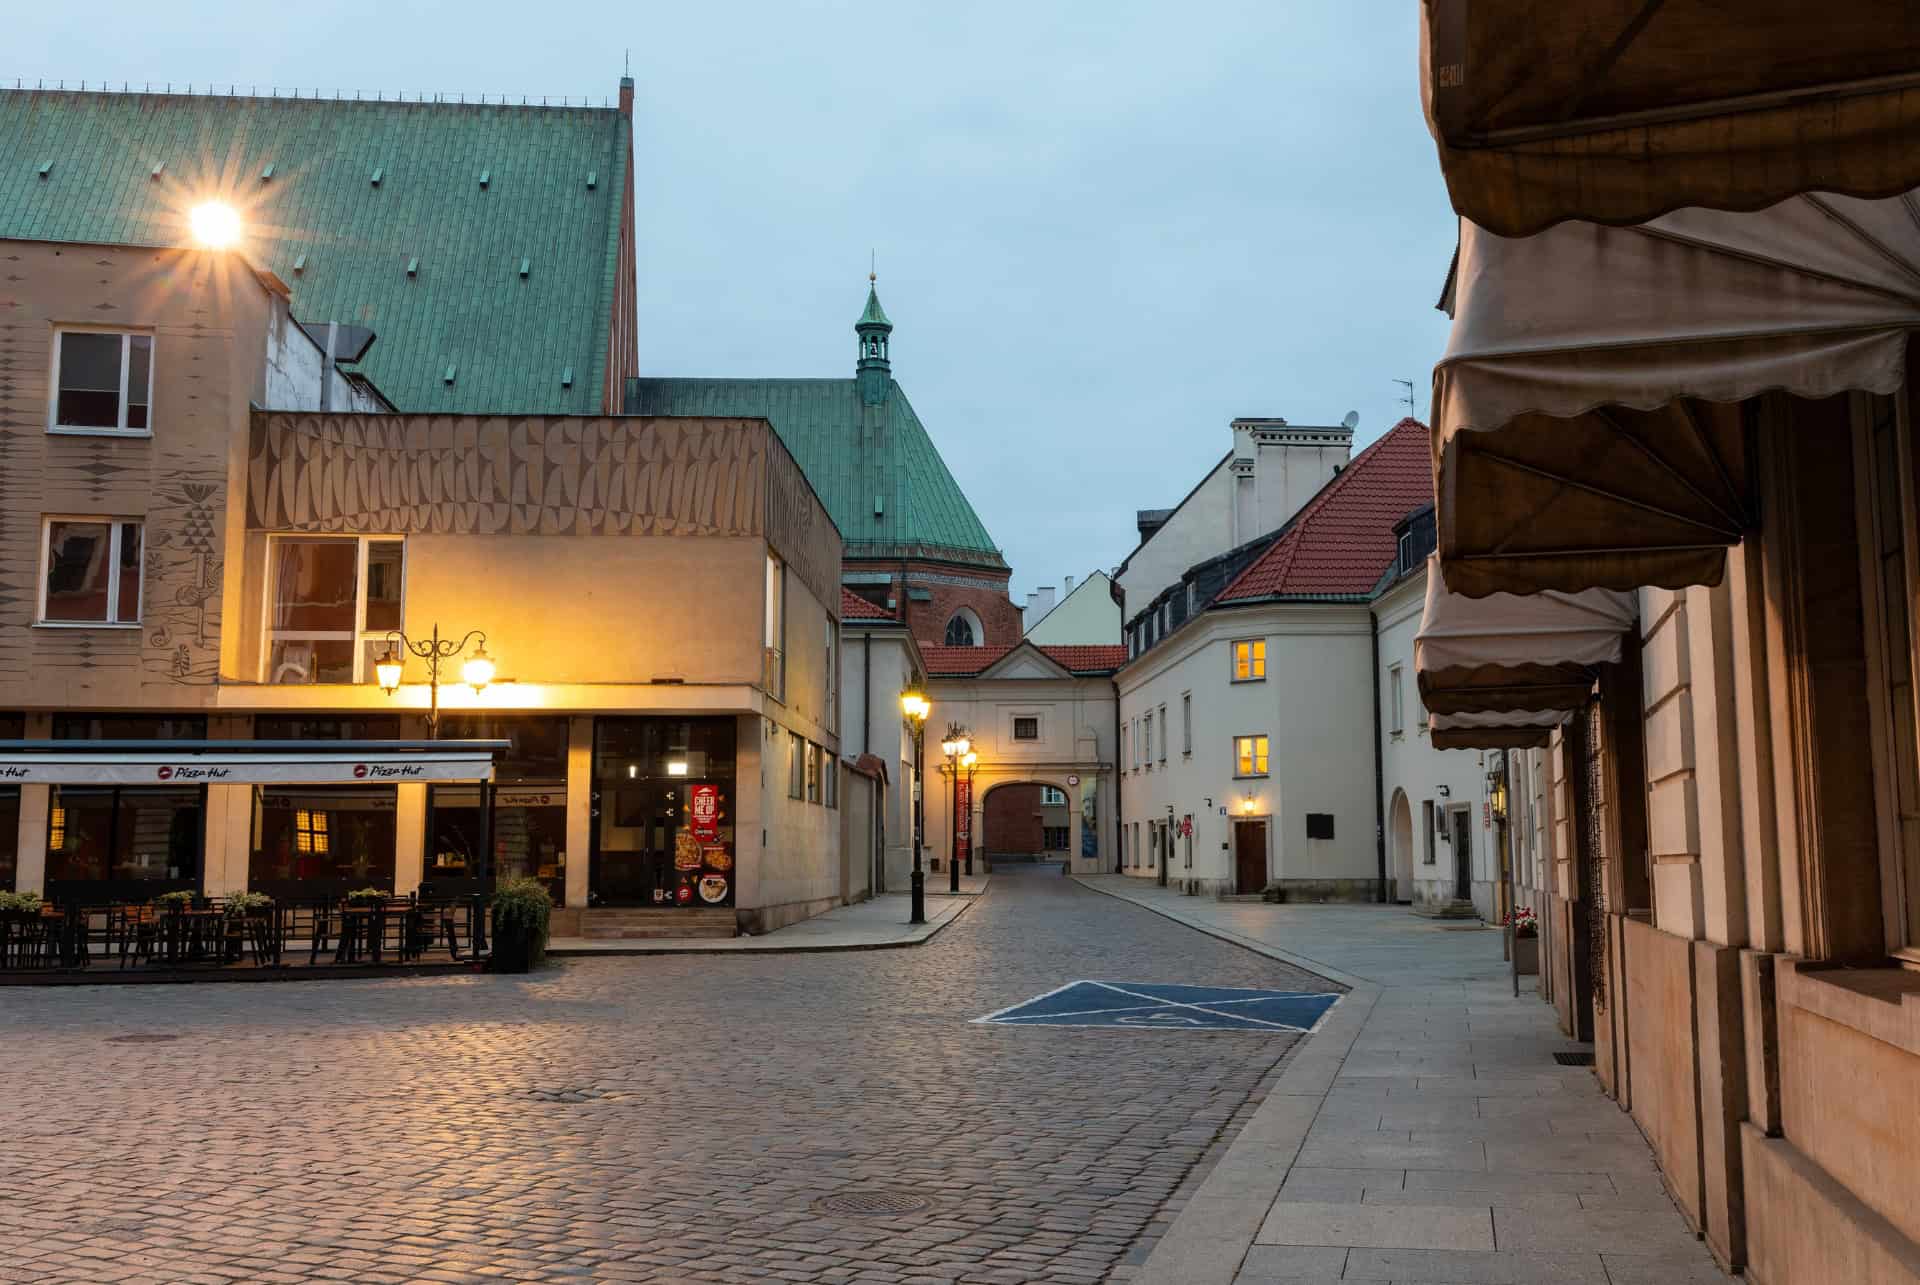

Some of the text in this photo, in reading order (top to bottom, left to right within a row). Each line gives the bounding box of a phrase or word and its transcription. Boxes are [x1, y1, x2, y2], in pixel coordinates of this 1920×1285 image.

[5, 766, 31, 777] Hut
[174, 767, 231, 778] Pizza Hut
[369, 764, 424, 776] Pizza Hut
